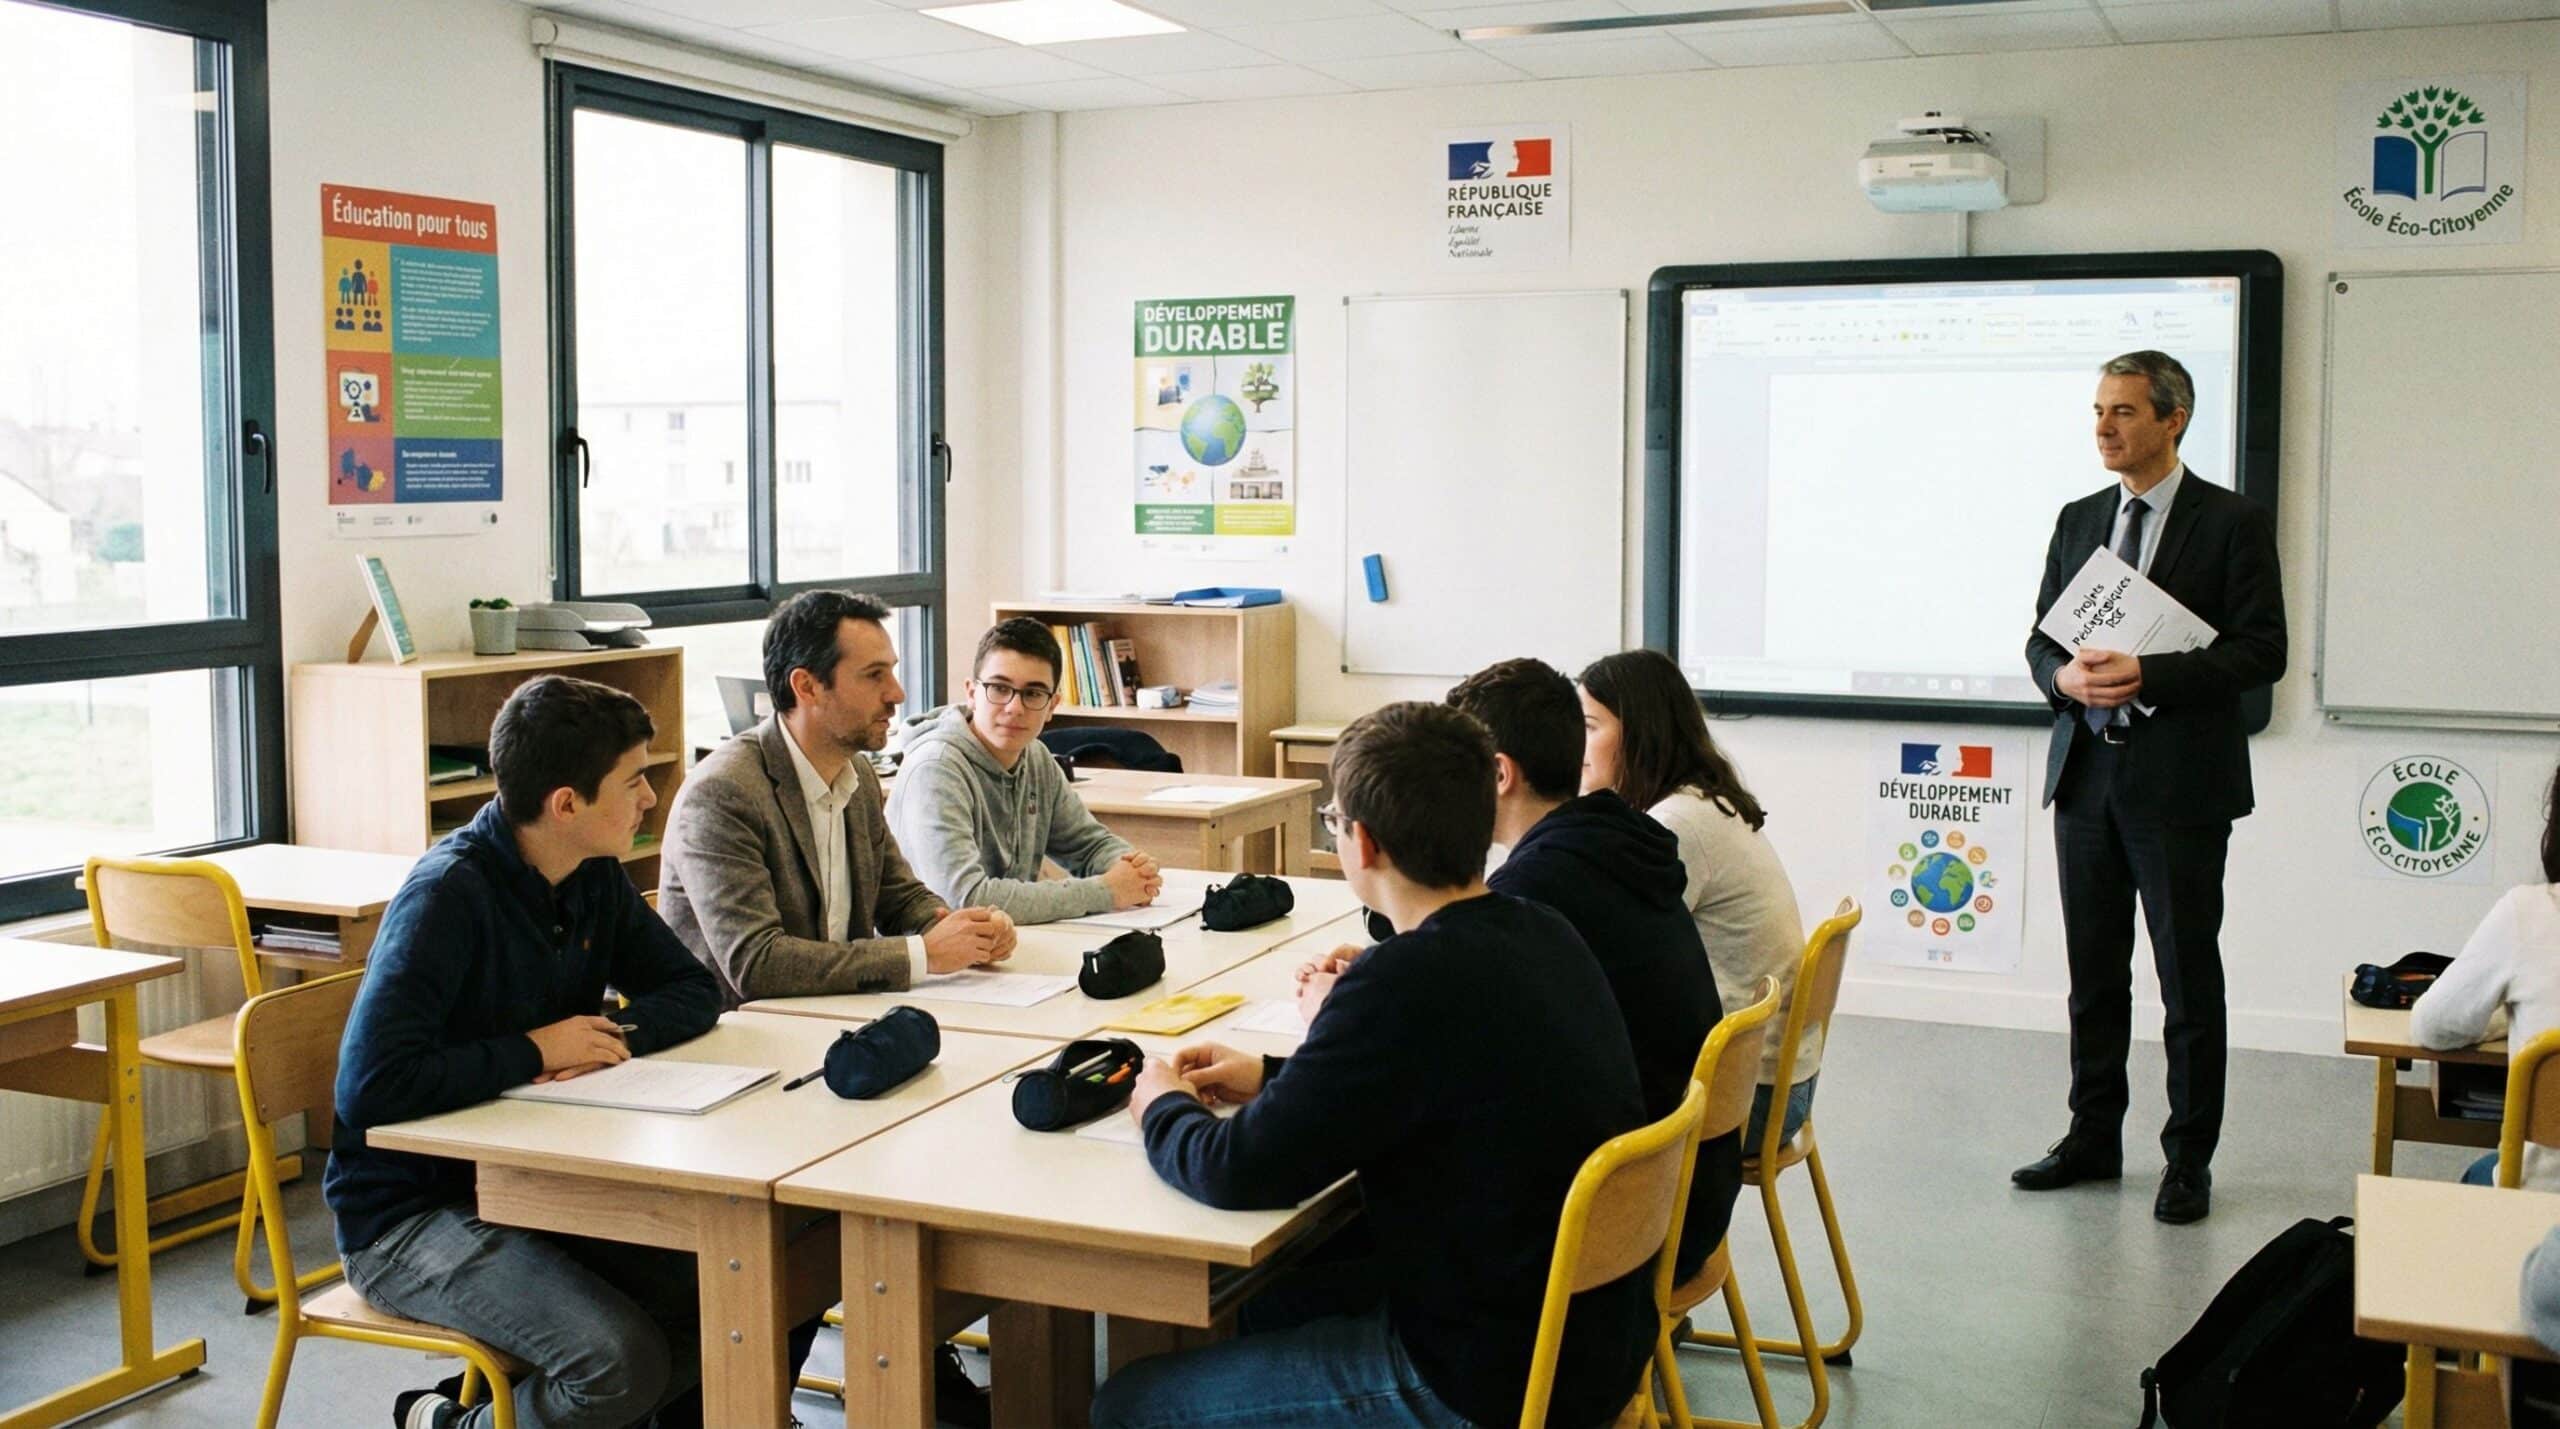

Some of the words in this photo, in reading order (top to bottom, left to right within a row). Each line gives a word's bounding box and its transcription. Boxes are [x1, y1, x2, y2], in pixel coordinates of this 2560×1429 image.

[1448, 183, 1552, 201] RÉPUBLIQUE
[332, 192, 412, 231] Éducation
[416, 214, 452, 237] pour
[455, 214, 488, 240] tous
[1448, 201, 1543, 220] FRANÇAISE
[2343, 185, 2385, 227] École
[2386, 183, 2515, 237] Éco-Citoyenne
[1144, 302, 1286, 322] DÉVELOPPEMENT
[1144, 322, 1286, 352] DURABLE
[2392, 761, 2460, 786] ÉCOLE
[1879, 778, 2013, 805] DÉVELOPPEMENT
[1909, 802, 1981, 823] DURABLE
[2366, 826, 2481, 873] ÉCO-CITOYENNE
